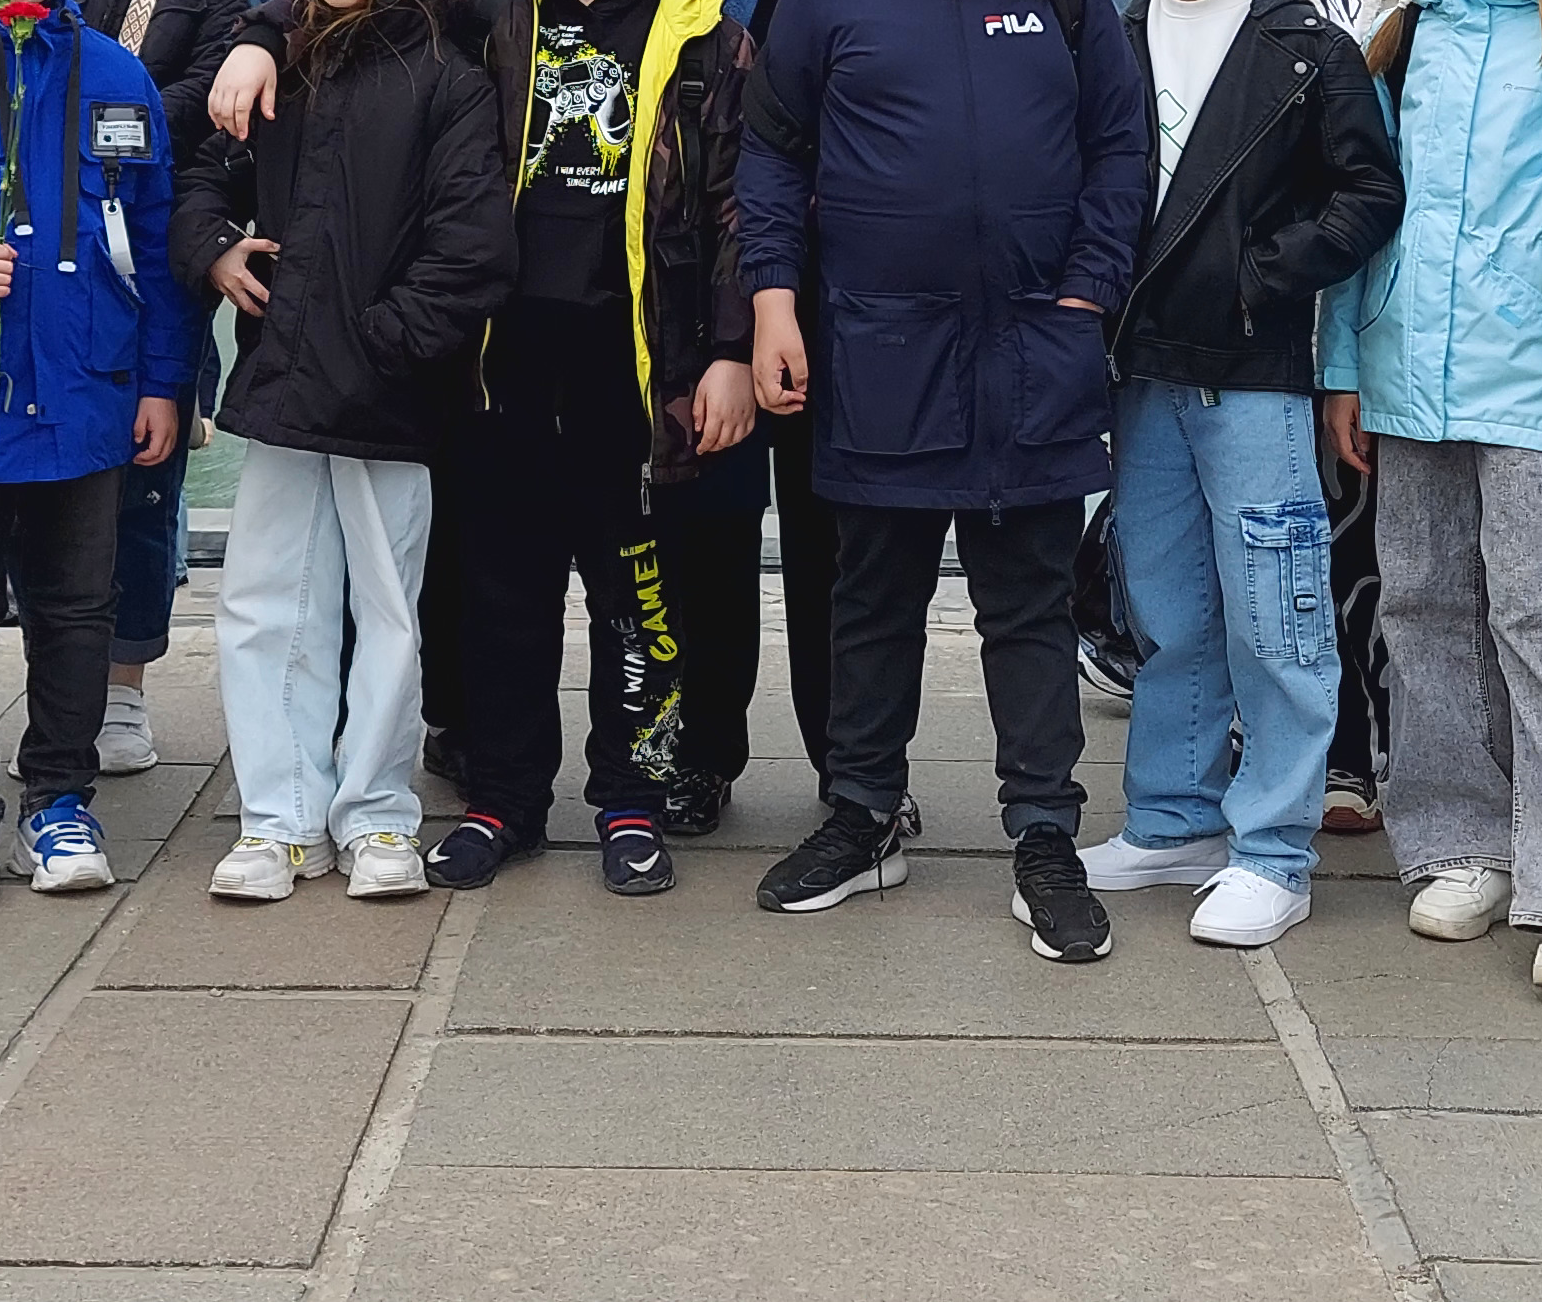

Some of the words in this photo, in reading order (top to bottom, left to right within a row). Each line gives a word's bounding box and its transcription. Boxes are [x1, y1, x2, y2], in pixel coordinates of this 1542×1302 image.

[984, 12, 1045, 36] FILA
[576, 166, 600, 176] EVERY
[566, 178, 591, 187] SINGLE
[591, 178, 628, 195] GAME
